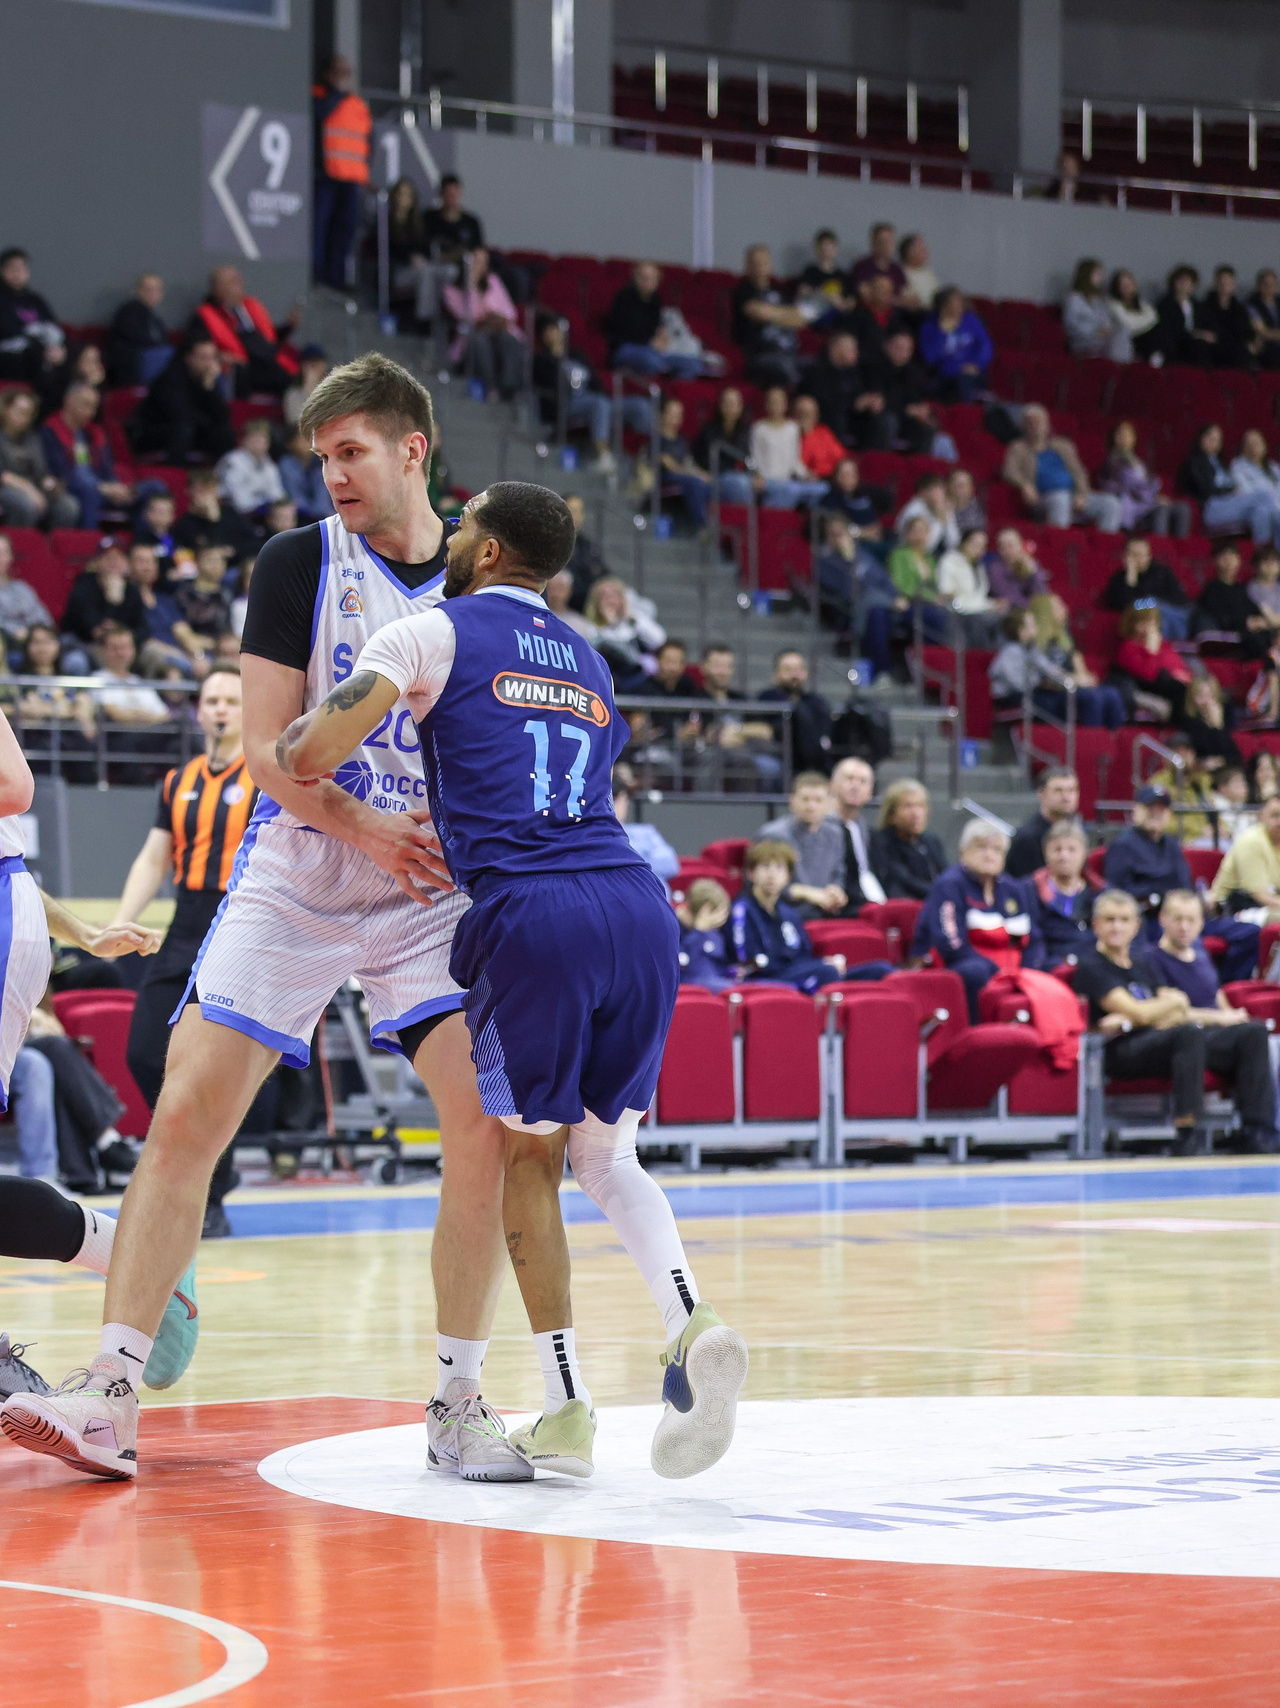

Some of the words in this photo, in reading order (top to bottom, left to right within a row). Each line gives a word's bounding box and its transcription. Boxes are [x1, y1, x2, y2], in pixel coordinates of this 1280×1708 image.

[260, 121, 291, 191] 9
[381, 132, 401, 186] 1
[514, 629, 579, 673] MOON
[505, 679, 588, 713] WINLINE
[361, 709, 421, 753] 20
[375, 772, 426, 798] РОСС
[523, 720, 591, 823] 17
[372, 796, 408, 813] ВОЛГА
[204, 992, 234, 1007] ZEDO
